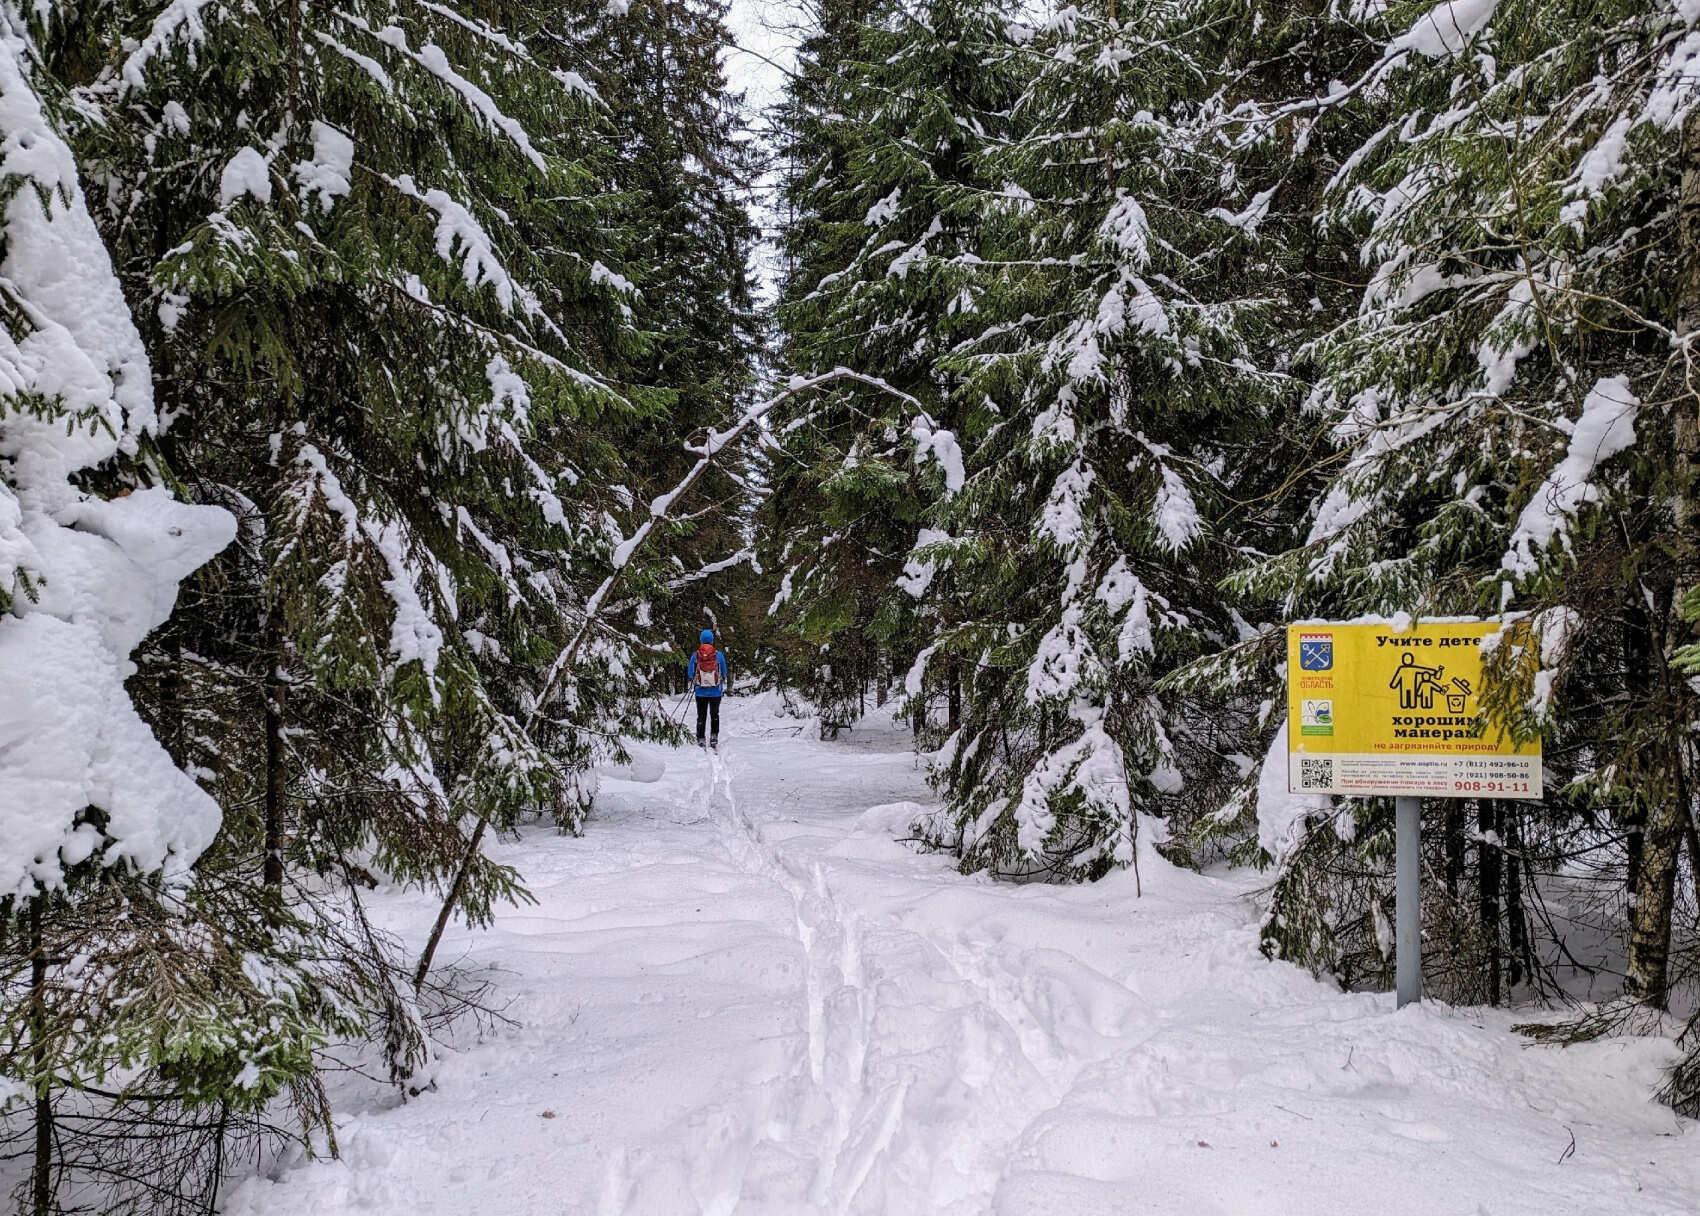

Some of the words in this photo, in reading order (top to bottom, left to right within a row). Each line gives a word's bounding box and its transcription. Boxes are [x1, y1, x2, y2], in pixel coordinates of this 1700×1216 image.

[1376, 635, 1433, 647] Учите
[1438, 636, 1481, 648] дете
[1300, 680, 1334, 689] ОБЛАСТЬ
[1394, 728, 1479, 741] манерам
[1374, 742, 1387, 750] не
[1389, 742, 1452, 752] загрязняйте
[1455, 742, 1500, 752] природу
[1466, 761, 1487, 769] (812)
[1454, 781, 1529, 792] 908-91-11
